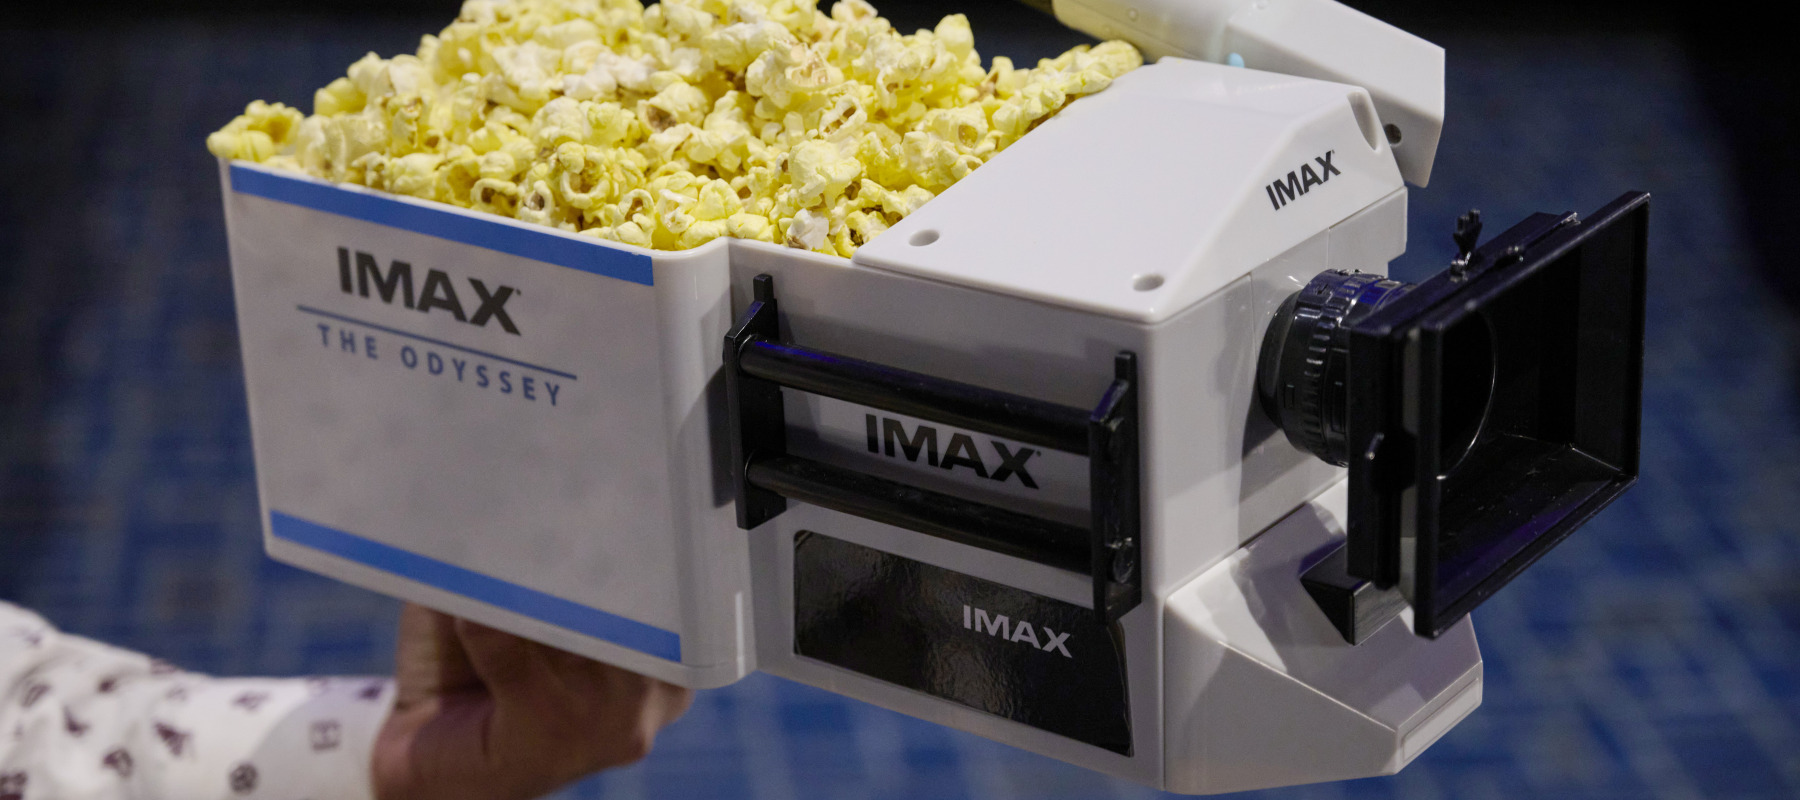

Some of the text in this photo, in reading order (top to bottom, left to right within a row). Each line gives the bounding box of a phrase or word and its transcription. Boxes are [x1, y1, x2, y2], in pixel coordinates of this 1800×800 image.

[1265, 150, 1342, 212] IMAX
[336, 246, 522, 337] IMAX
[316, 323, 560, 407] THE ODYSSEY
[865, 413, 1040, 490] IMAX
[963, 604, 1073, 659] IMAX
